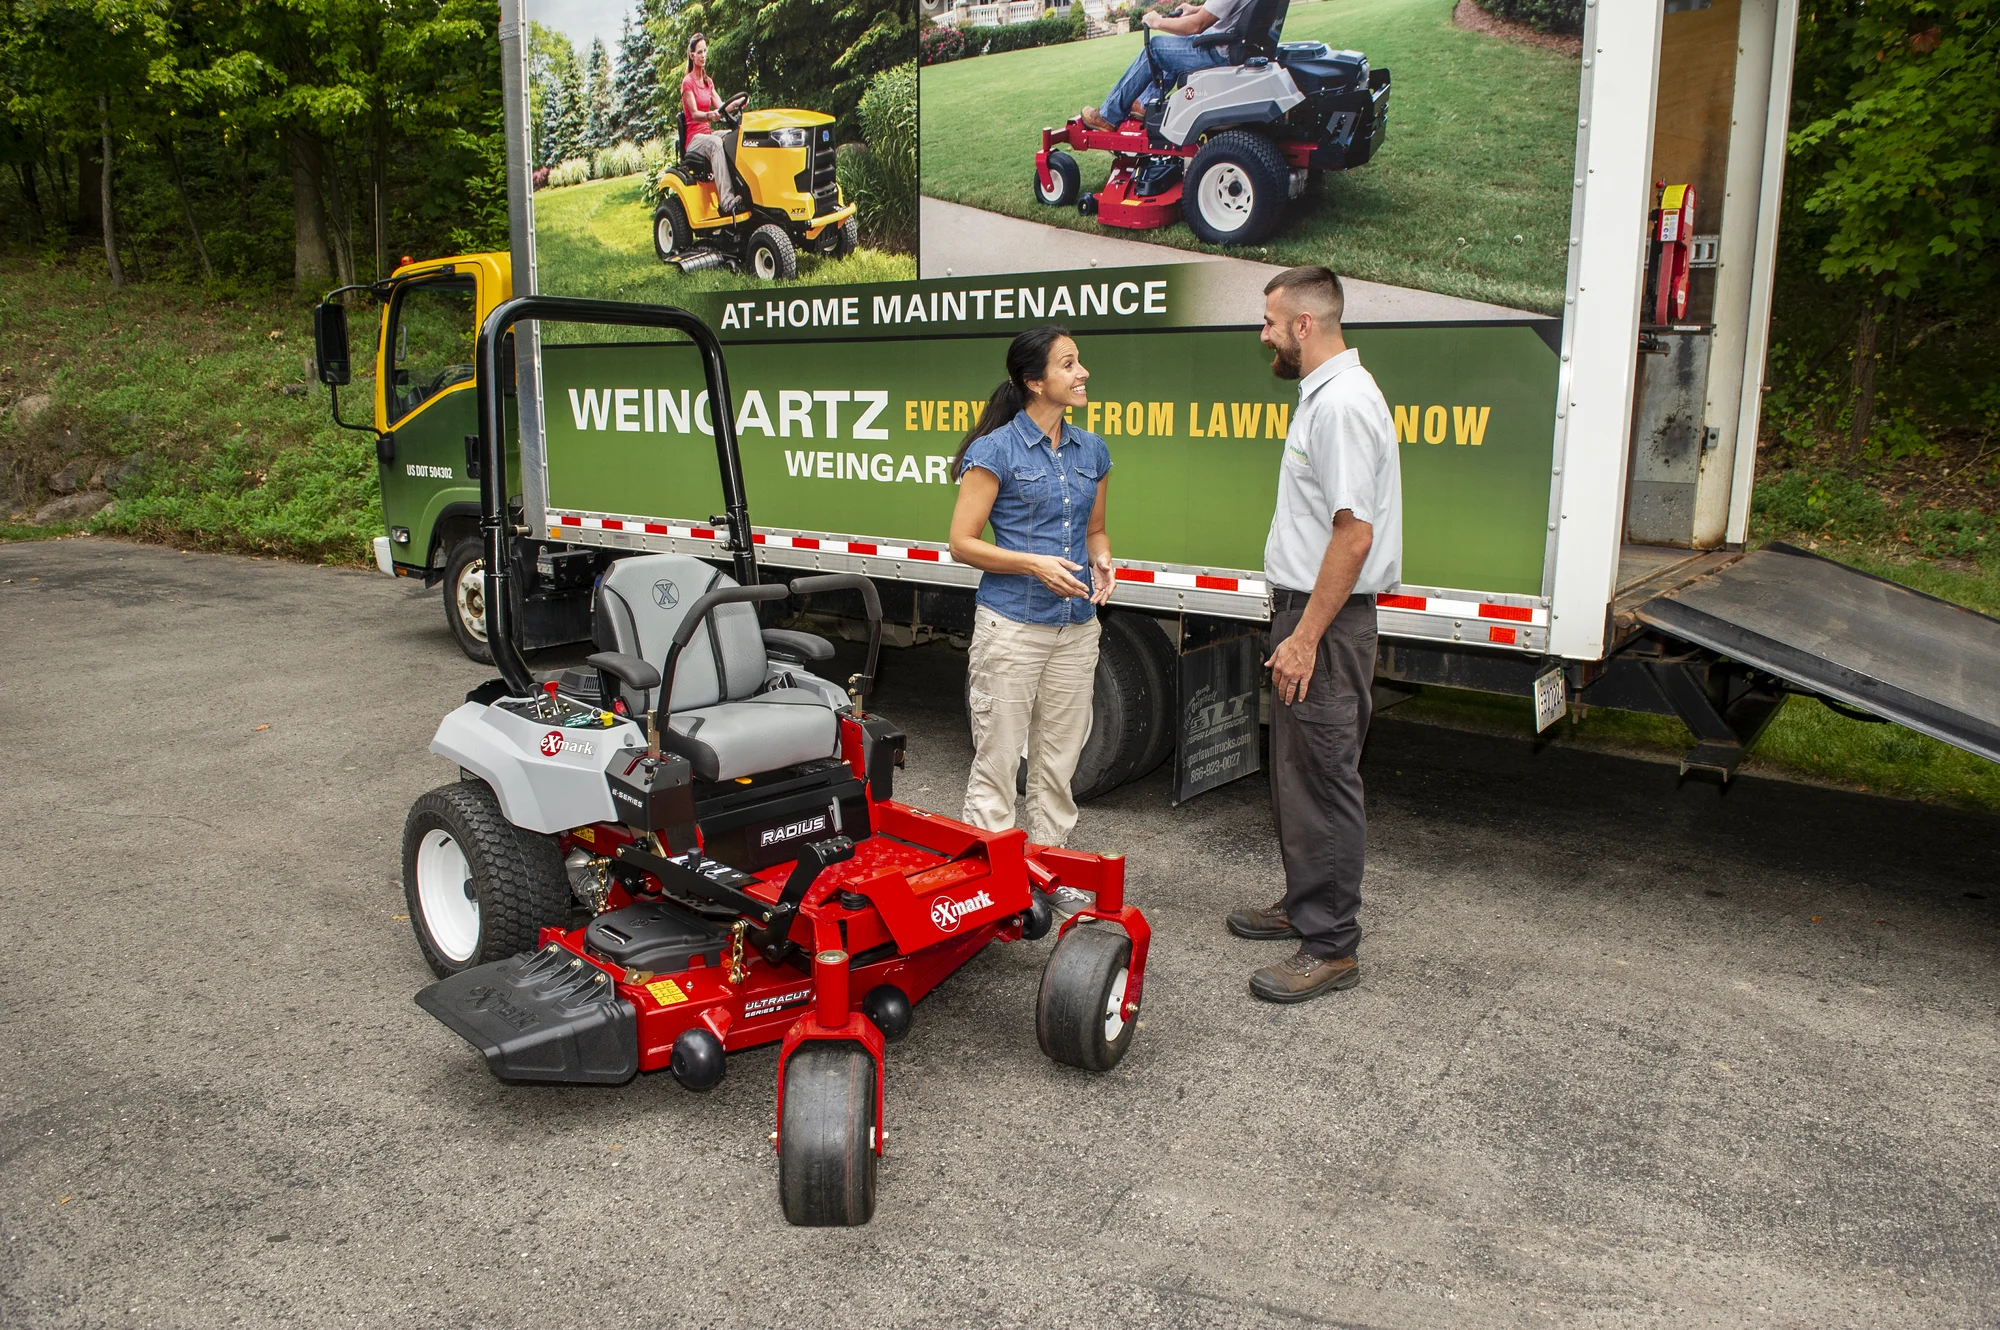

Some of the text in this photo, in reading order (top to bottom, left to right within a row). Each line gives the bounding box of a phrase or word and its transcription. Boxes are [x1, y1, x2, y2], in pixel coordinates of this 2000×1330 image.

[721, 281, 1167, 330] AT-HOME MAINTENANCE
[1087, 401, 1174, 436] FROM
[1189, 402, 1289, 439] LAWN
[406, 464, 453, 479] US DOT 504302
[1205, 723, 1224, 738] LAWN
[1224, 717, 1247, 730] TRUCKS
[1190, 752, 1241, 784] 866-923-0027
[612, 788, 643, 808] E-SERIES
[761, 815, 825, 847] RADIUS
[745, 989, 811, 1011] ULTRACUT
[744, 1006, 775, 1019] SERIES
